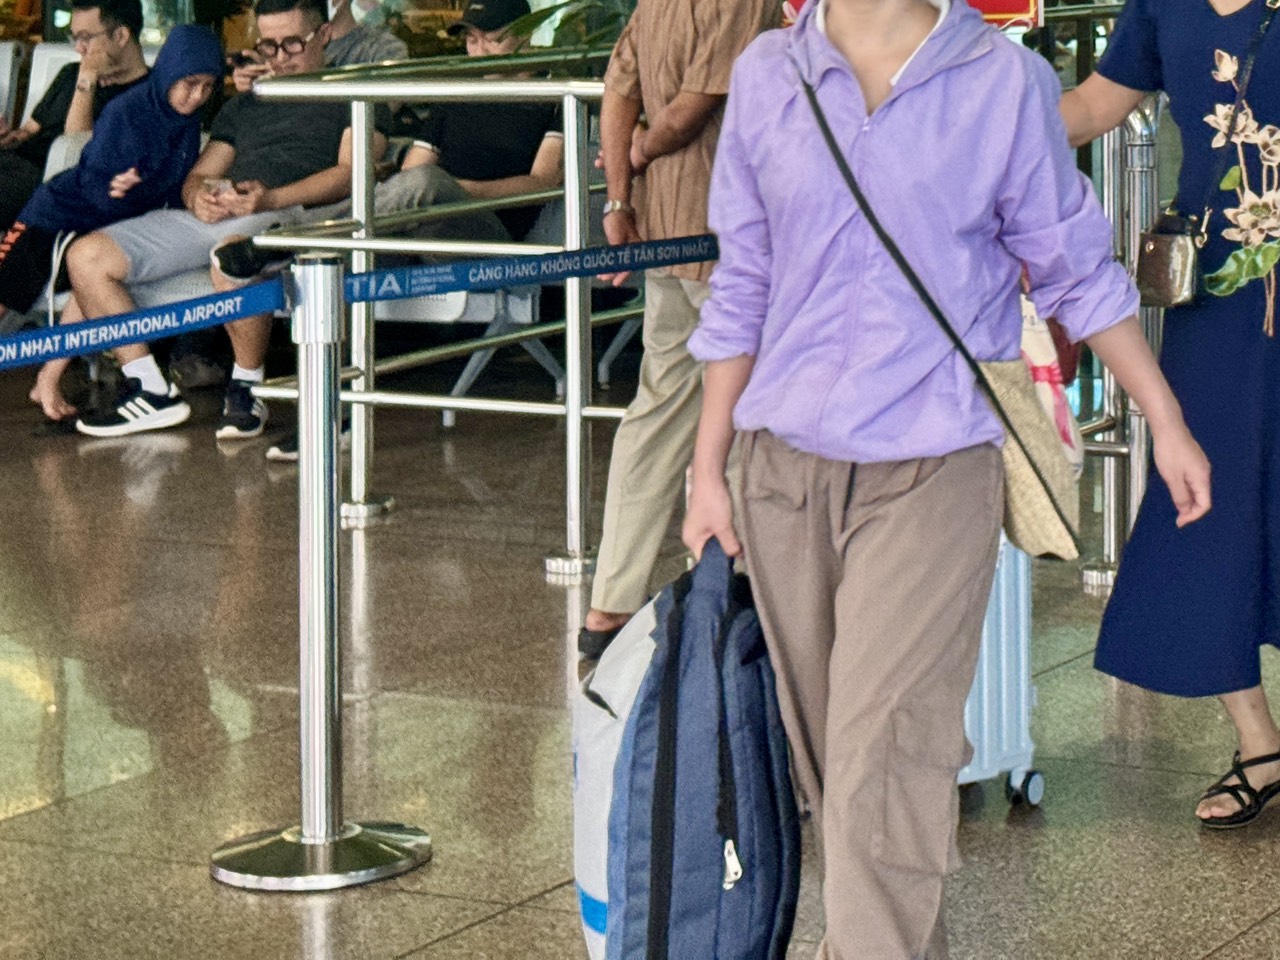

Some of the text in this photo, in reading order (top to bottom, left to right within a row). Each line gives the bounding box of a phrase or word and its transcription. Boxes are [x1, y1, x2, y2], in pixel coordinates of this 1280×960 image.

[540, 256, 579, 274] KHÔNG
[20, 334, 63, 359] NHAT
[64, 311, 180, 351] INTERNATIONAL
[182, 296, 243, 326] AIRPORT
